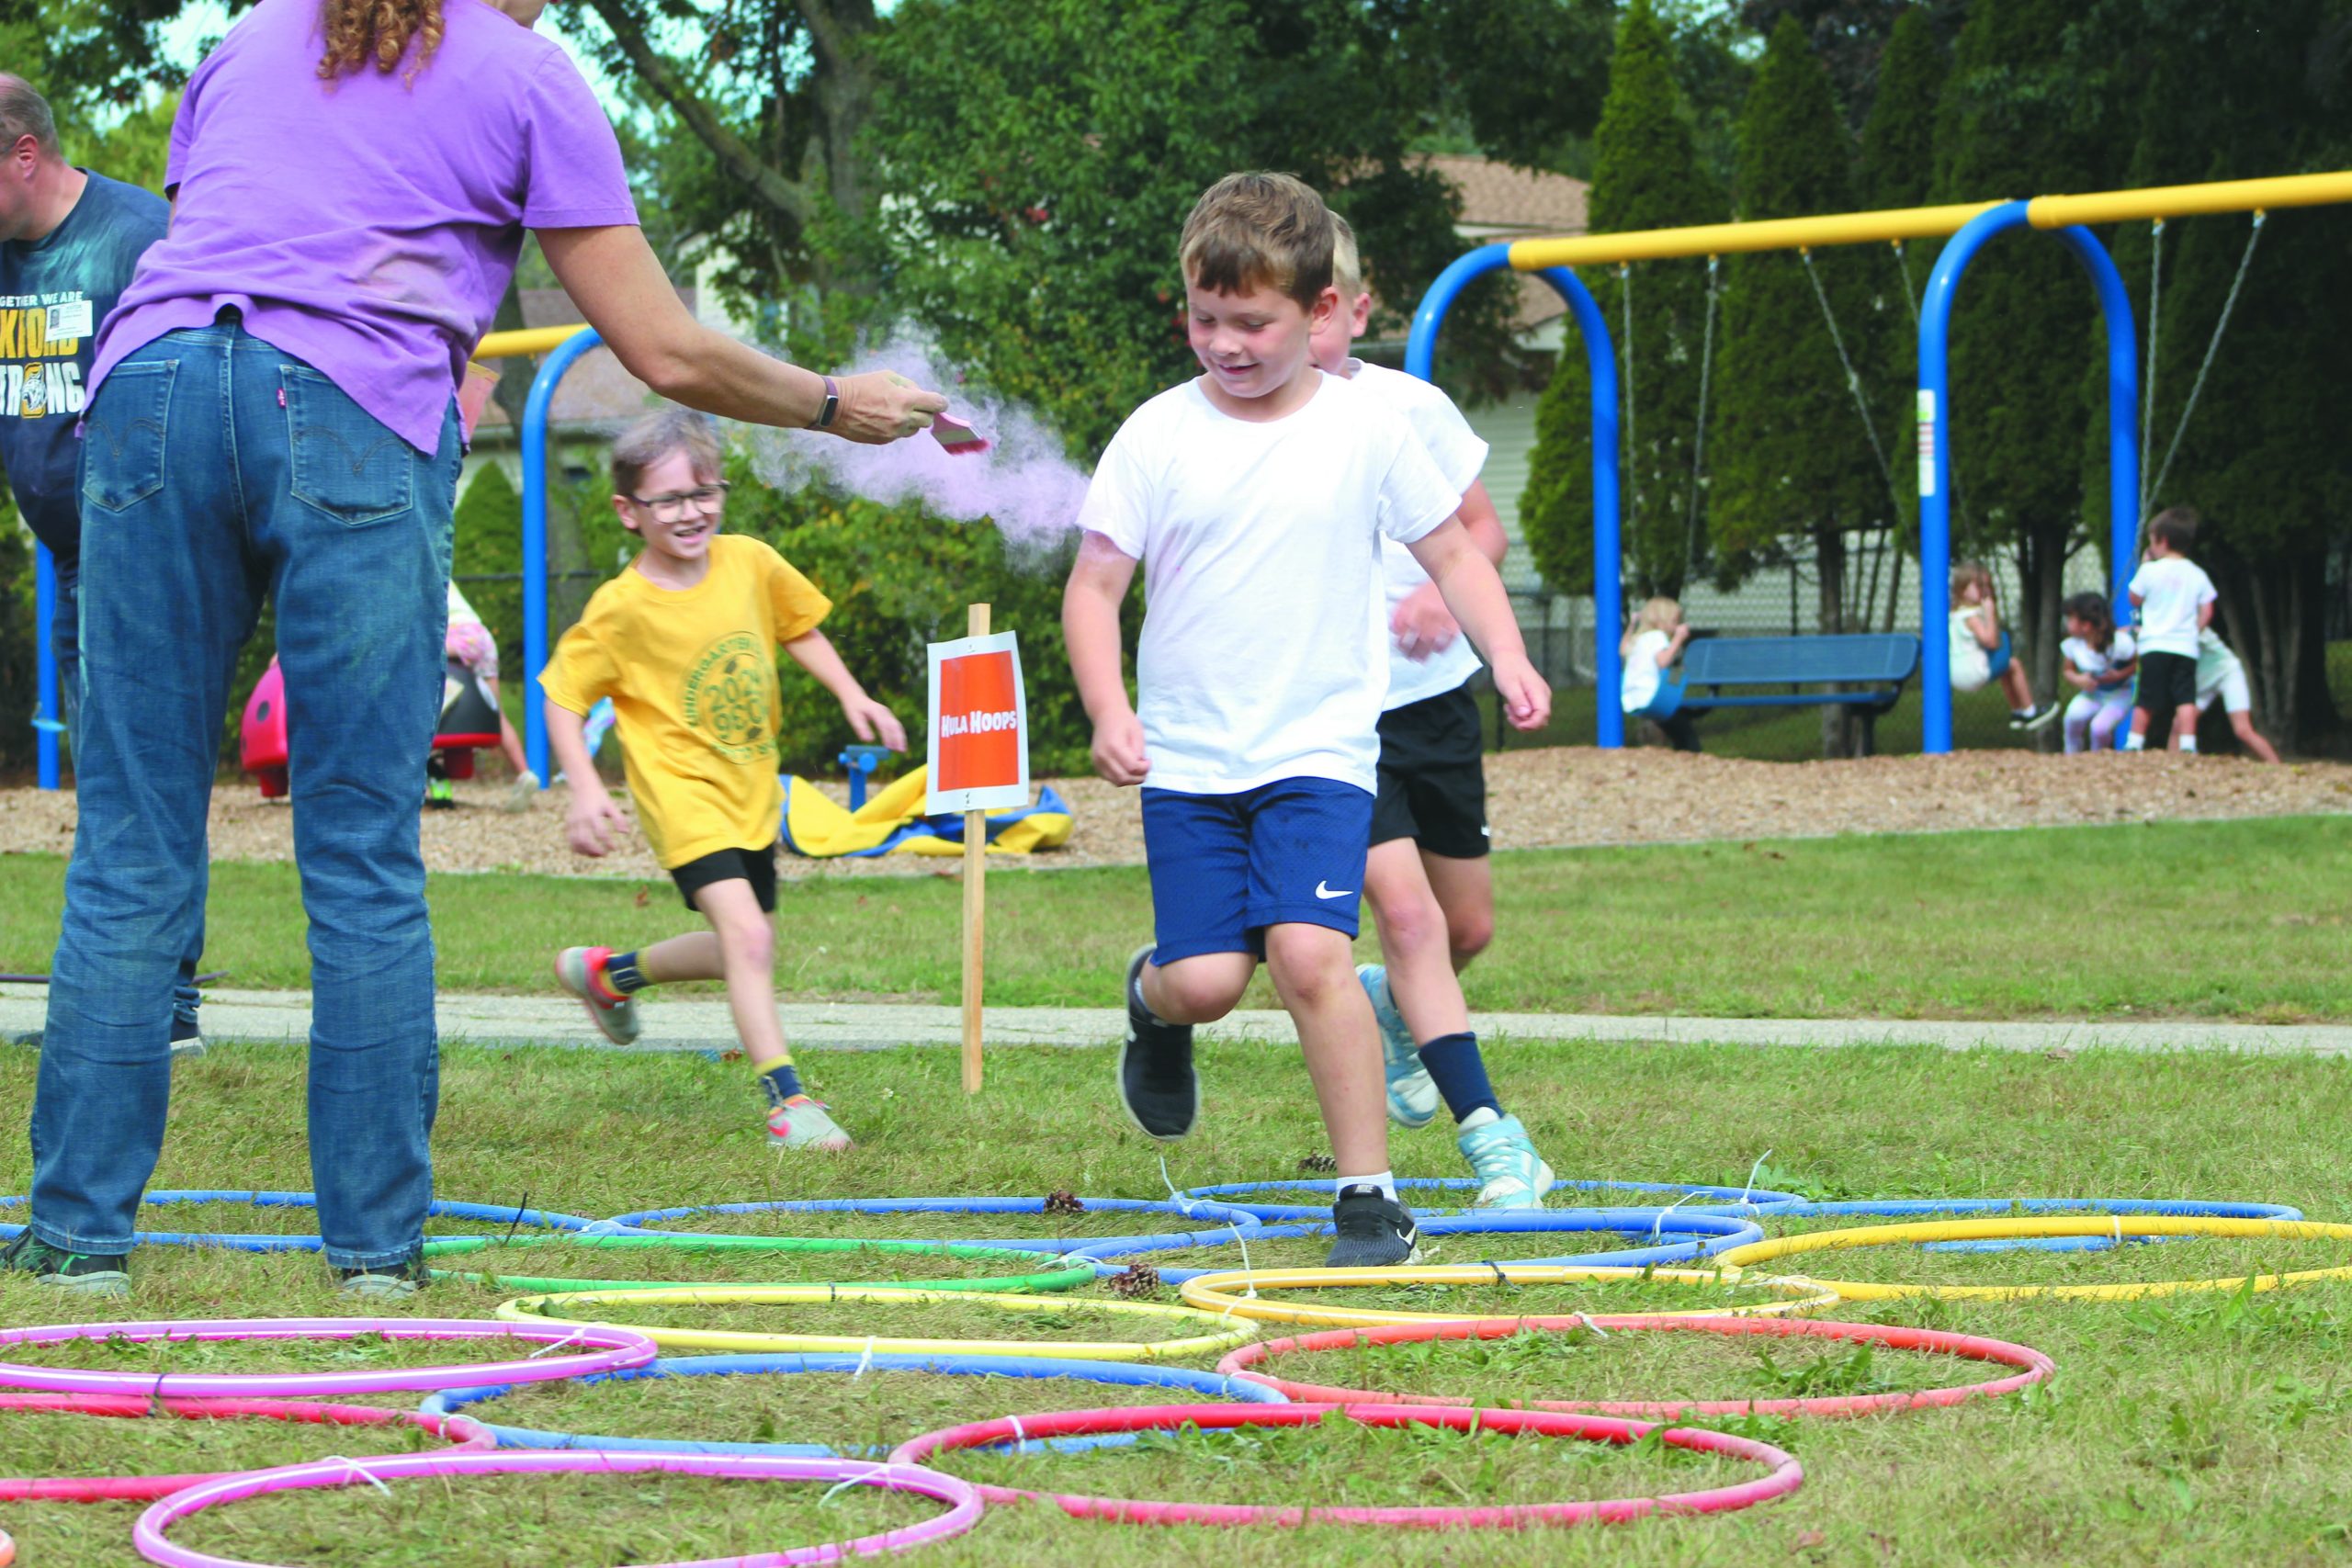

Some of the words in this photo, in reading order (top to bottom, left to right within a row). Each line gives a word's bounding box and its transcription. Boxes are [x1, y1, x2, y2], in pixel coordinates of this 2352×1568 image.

[41, 292, 58, 305] WE
[60, 291, 84, 302] ARE
[942, 715, 967, 738] HULA
[970, 710, 1017, 734] HOOPS
